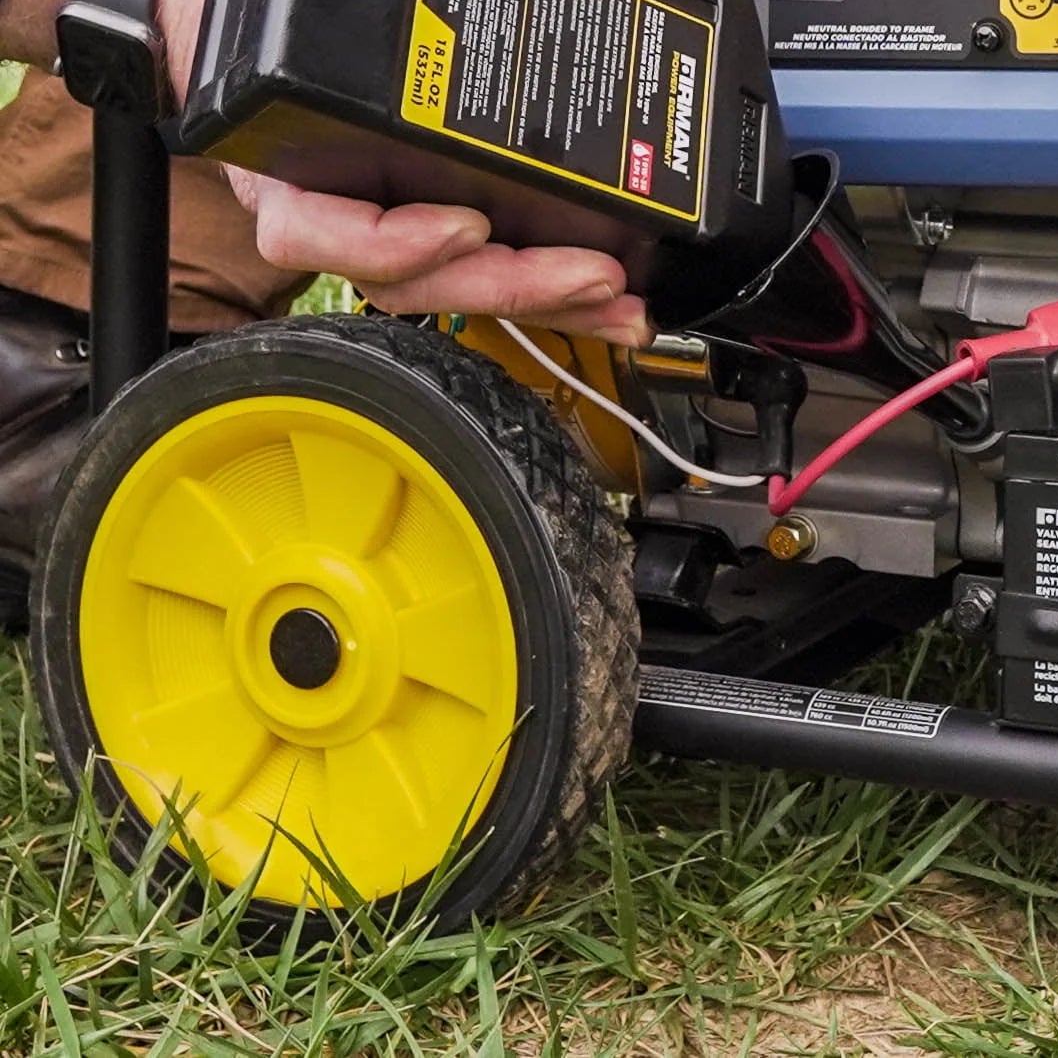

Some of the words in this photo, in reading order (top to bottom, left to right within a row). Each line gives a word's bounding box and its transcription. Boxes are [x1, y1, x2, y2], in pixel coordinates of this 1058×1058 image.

[434, 37, 446, 57] 18
[808, 25, 847, 33] NEUTRAL
[850, 25, 888, 33] BONDED
[904, 25, 935, 33] FRAME
[831, 34, 884, 42] CONECTADO
[886, 34, 897, 42] AL
[900, 34, 946, 42] BASTIDOR
[410, 43, 430, 106] (532ml)
[426, 60, 443, 111] FL.OZ.
[669, 50, 680, 95] POWER
[662, 95, 676, 168] EQUIPMENT
[670, 52, 696, 174] FIRMAN
[1035, 683, 1045, 695] La
